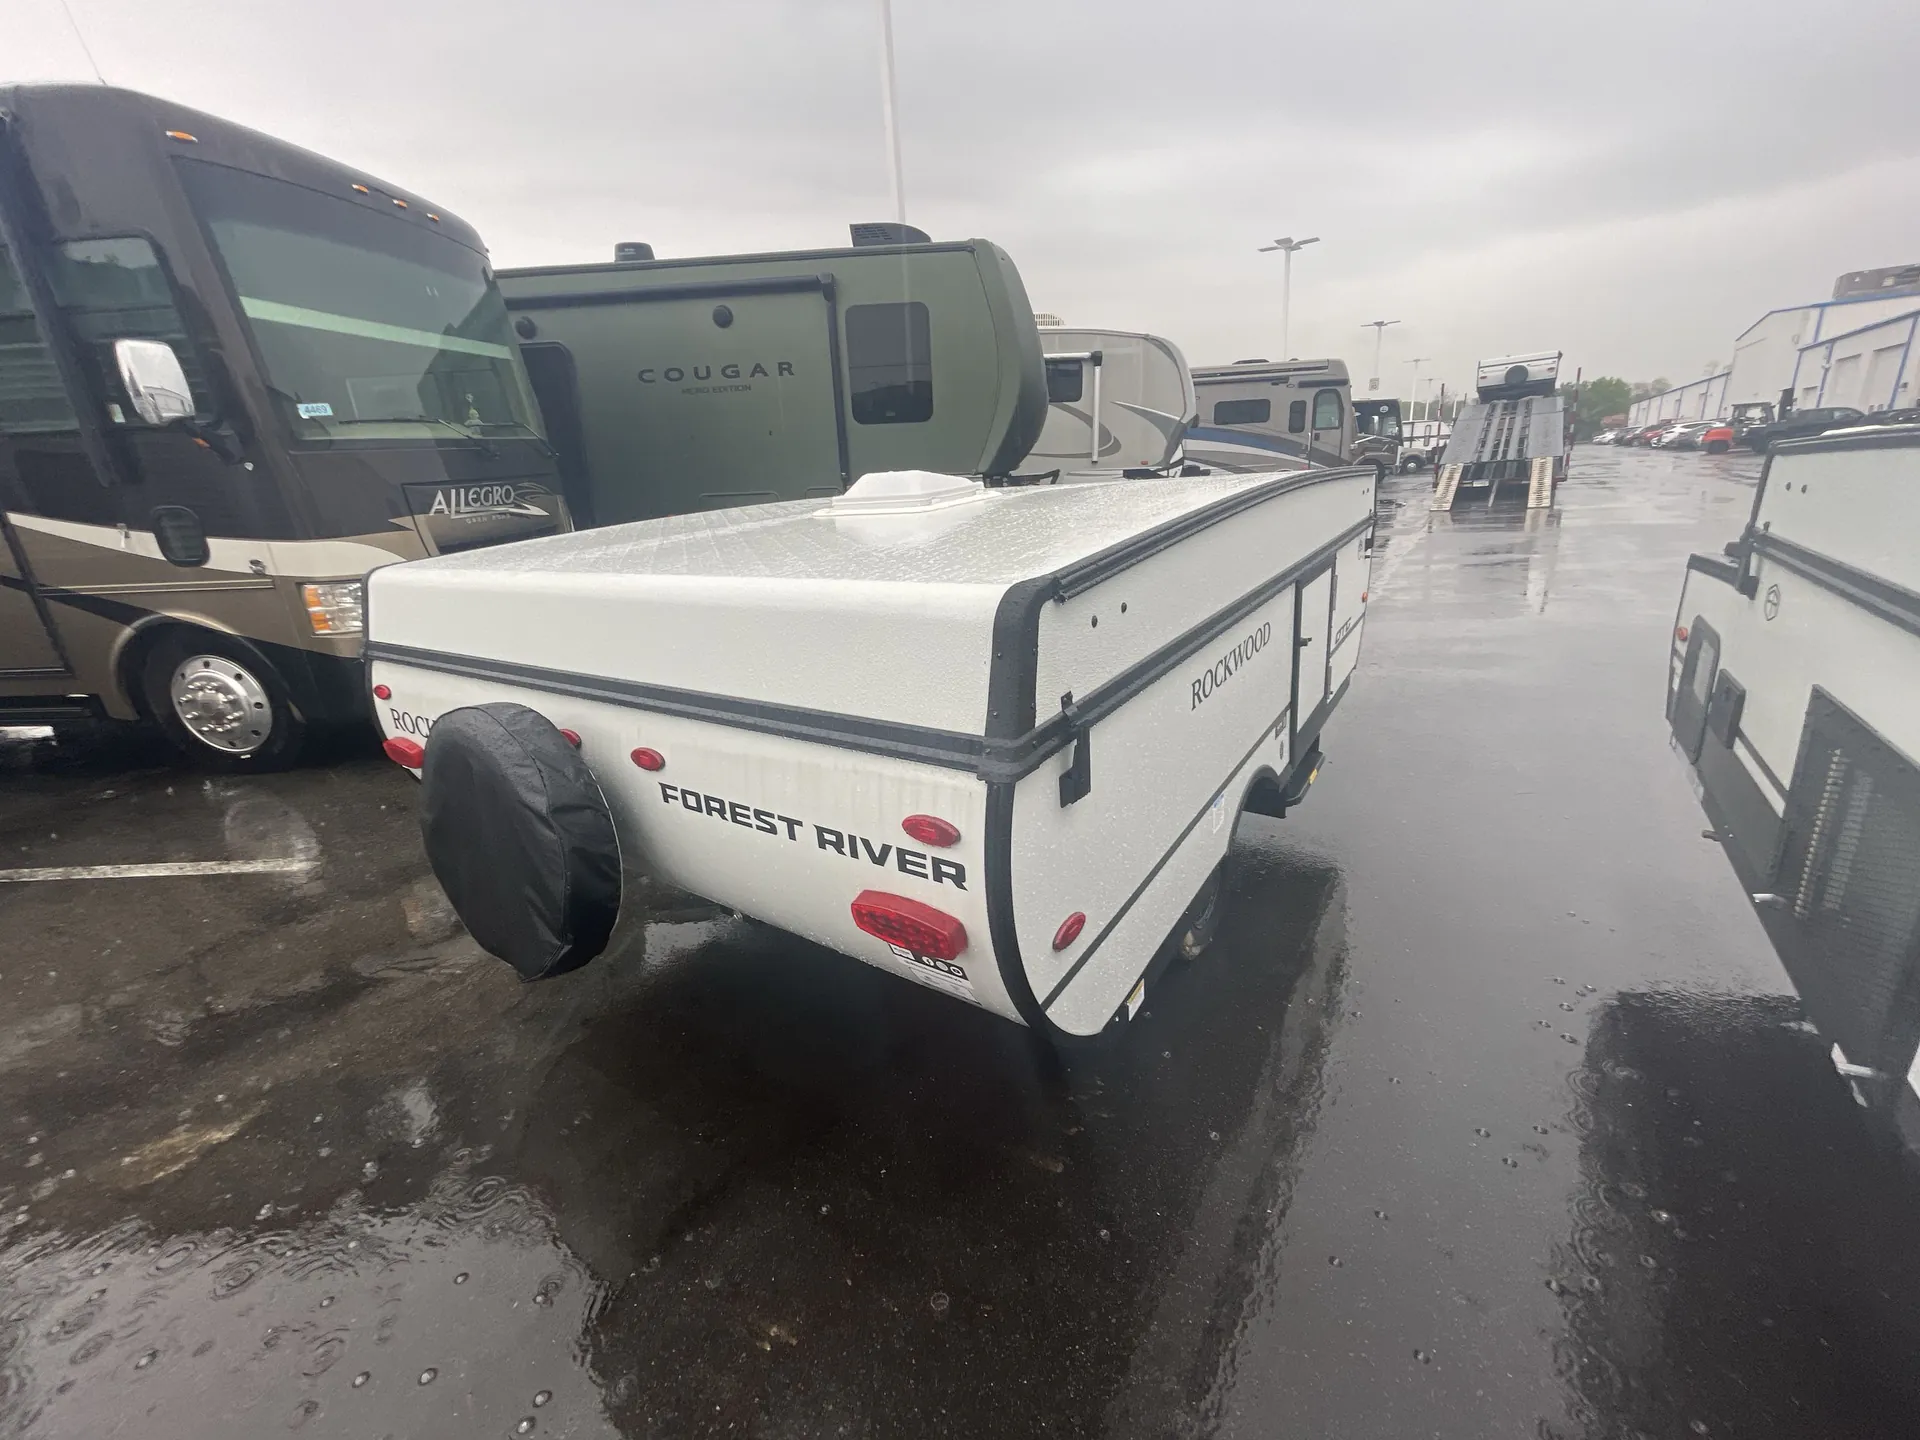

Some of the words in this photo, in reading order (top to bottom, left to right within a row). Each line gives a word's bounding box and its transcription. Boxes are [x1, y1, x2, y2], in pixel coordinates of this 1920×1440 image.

[638, 361, 795, 383] COUGAR
[429, 485, 515, 519] ALLEGRO
[1191, 621, 1271, 711] ROCKWOOD
[657, 781, 803, 841] FOREST
[812, 823, 968, 891] RIVER
